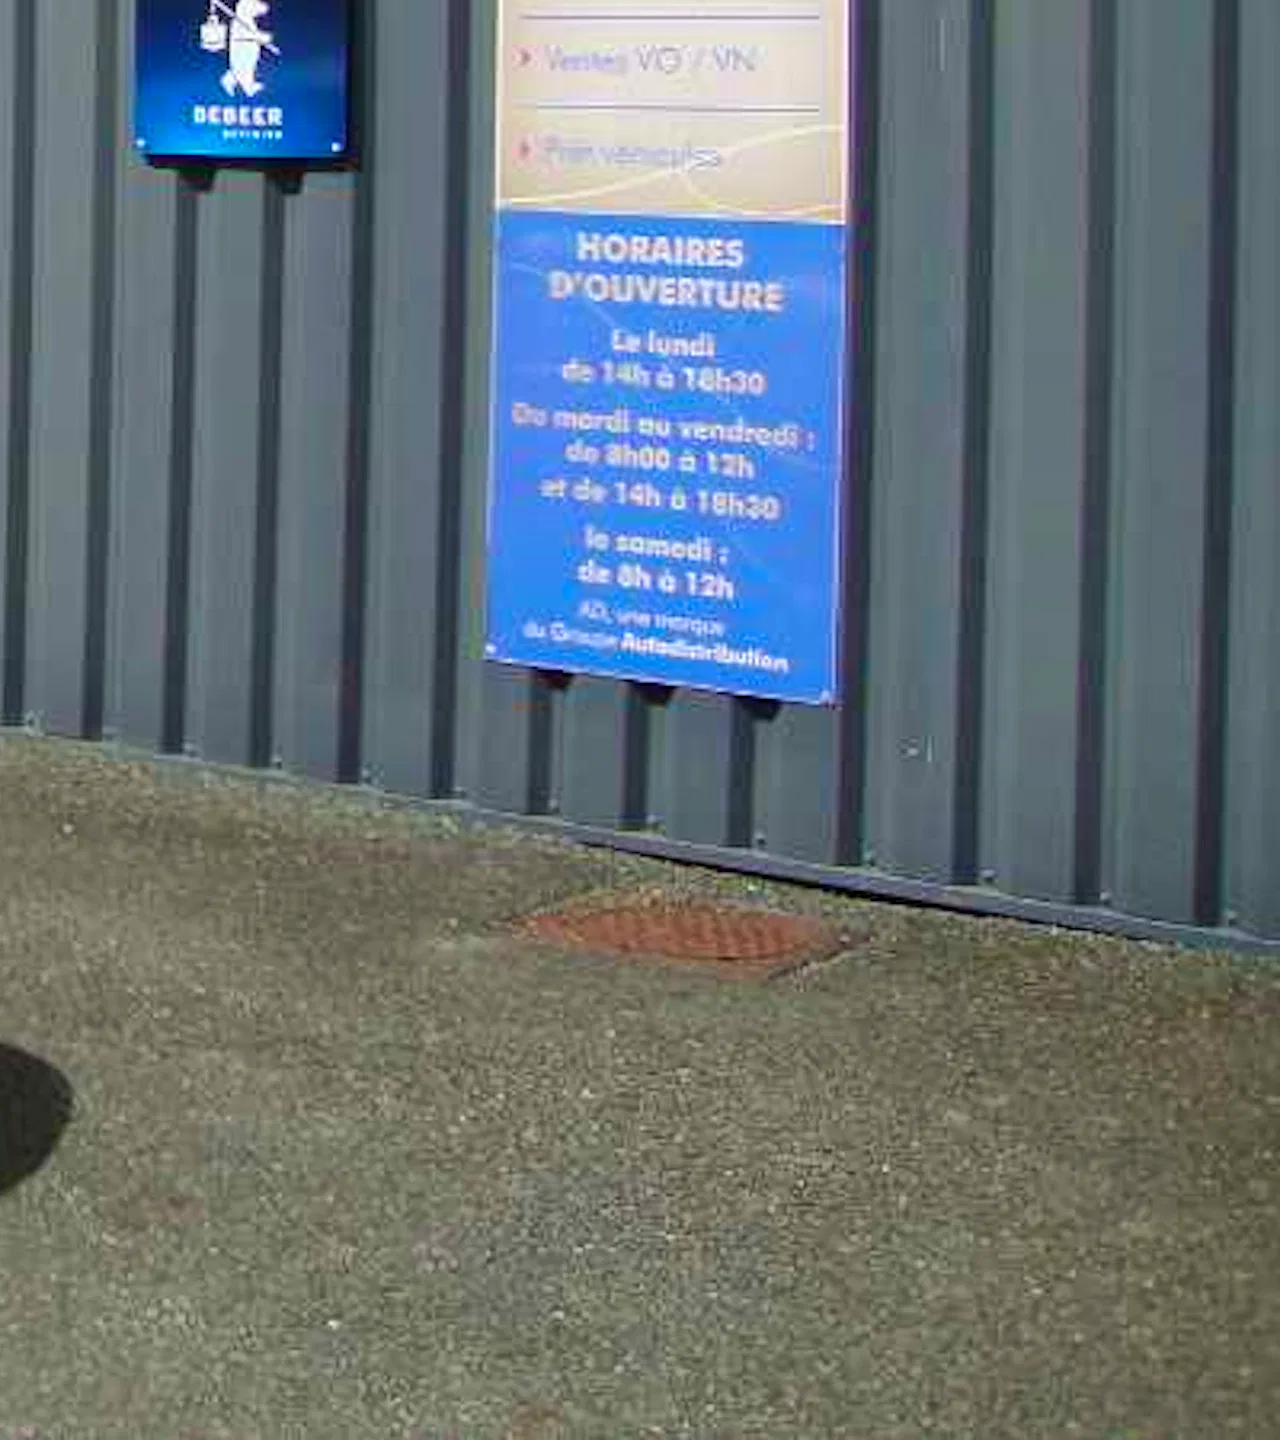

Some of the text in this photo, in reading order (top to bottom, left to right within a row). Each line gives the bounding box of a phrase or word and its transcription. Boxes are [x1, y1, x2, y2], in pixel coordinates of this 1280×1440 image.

[576, 231, 744, 268] HORAIRES
[549, 271, 785, 312] D'OUVERTURE
[612, 329, 716, 358] Le lundi
[562, 360, 592, 383] de
[602, 361, 649, 387] 14h
[554, 406, 630, 435] mardi
[677, 412, 798, 450] vendredi
[707, 450, 756, 479] 12h
[614, 481, 661, 508] 14h
[614, 531, 712, 561] samedi
[686, 570, 734, 601] 12h
